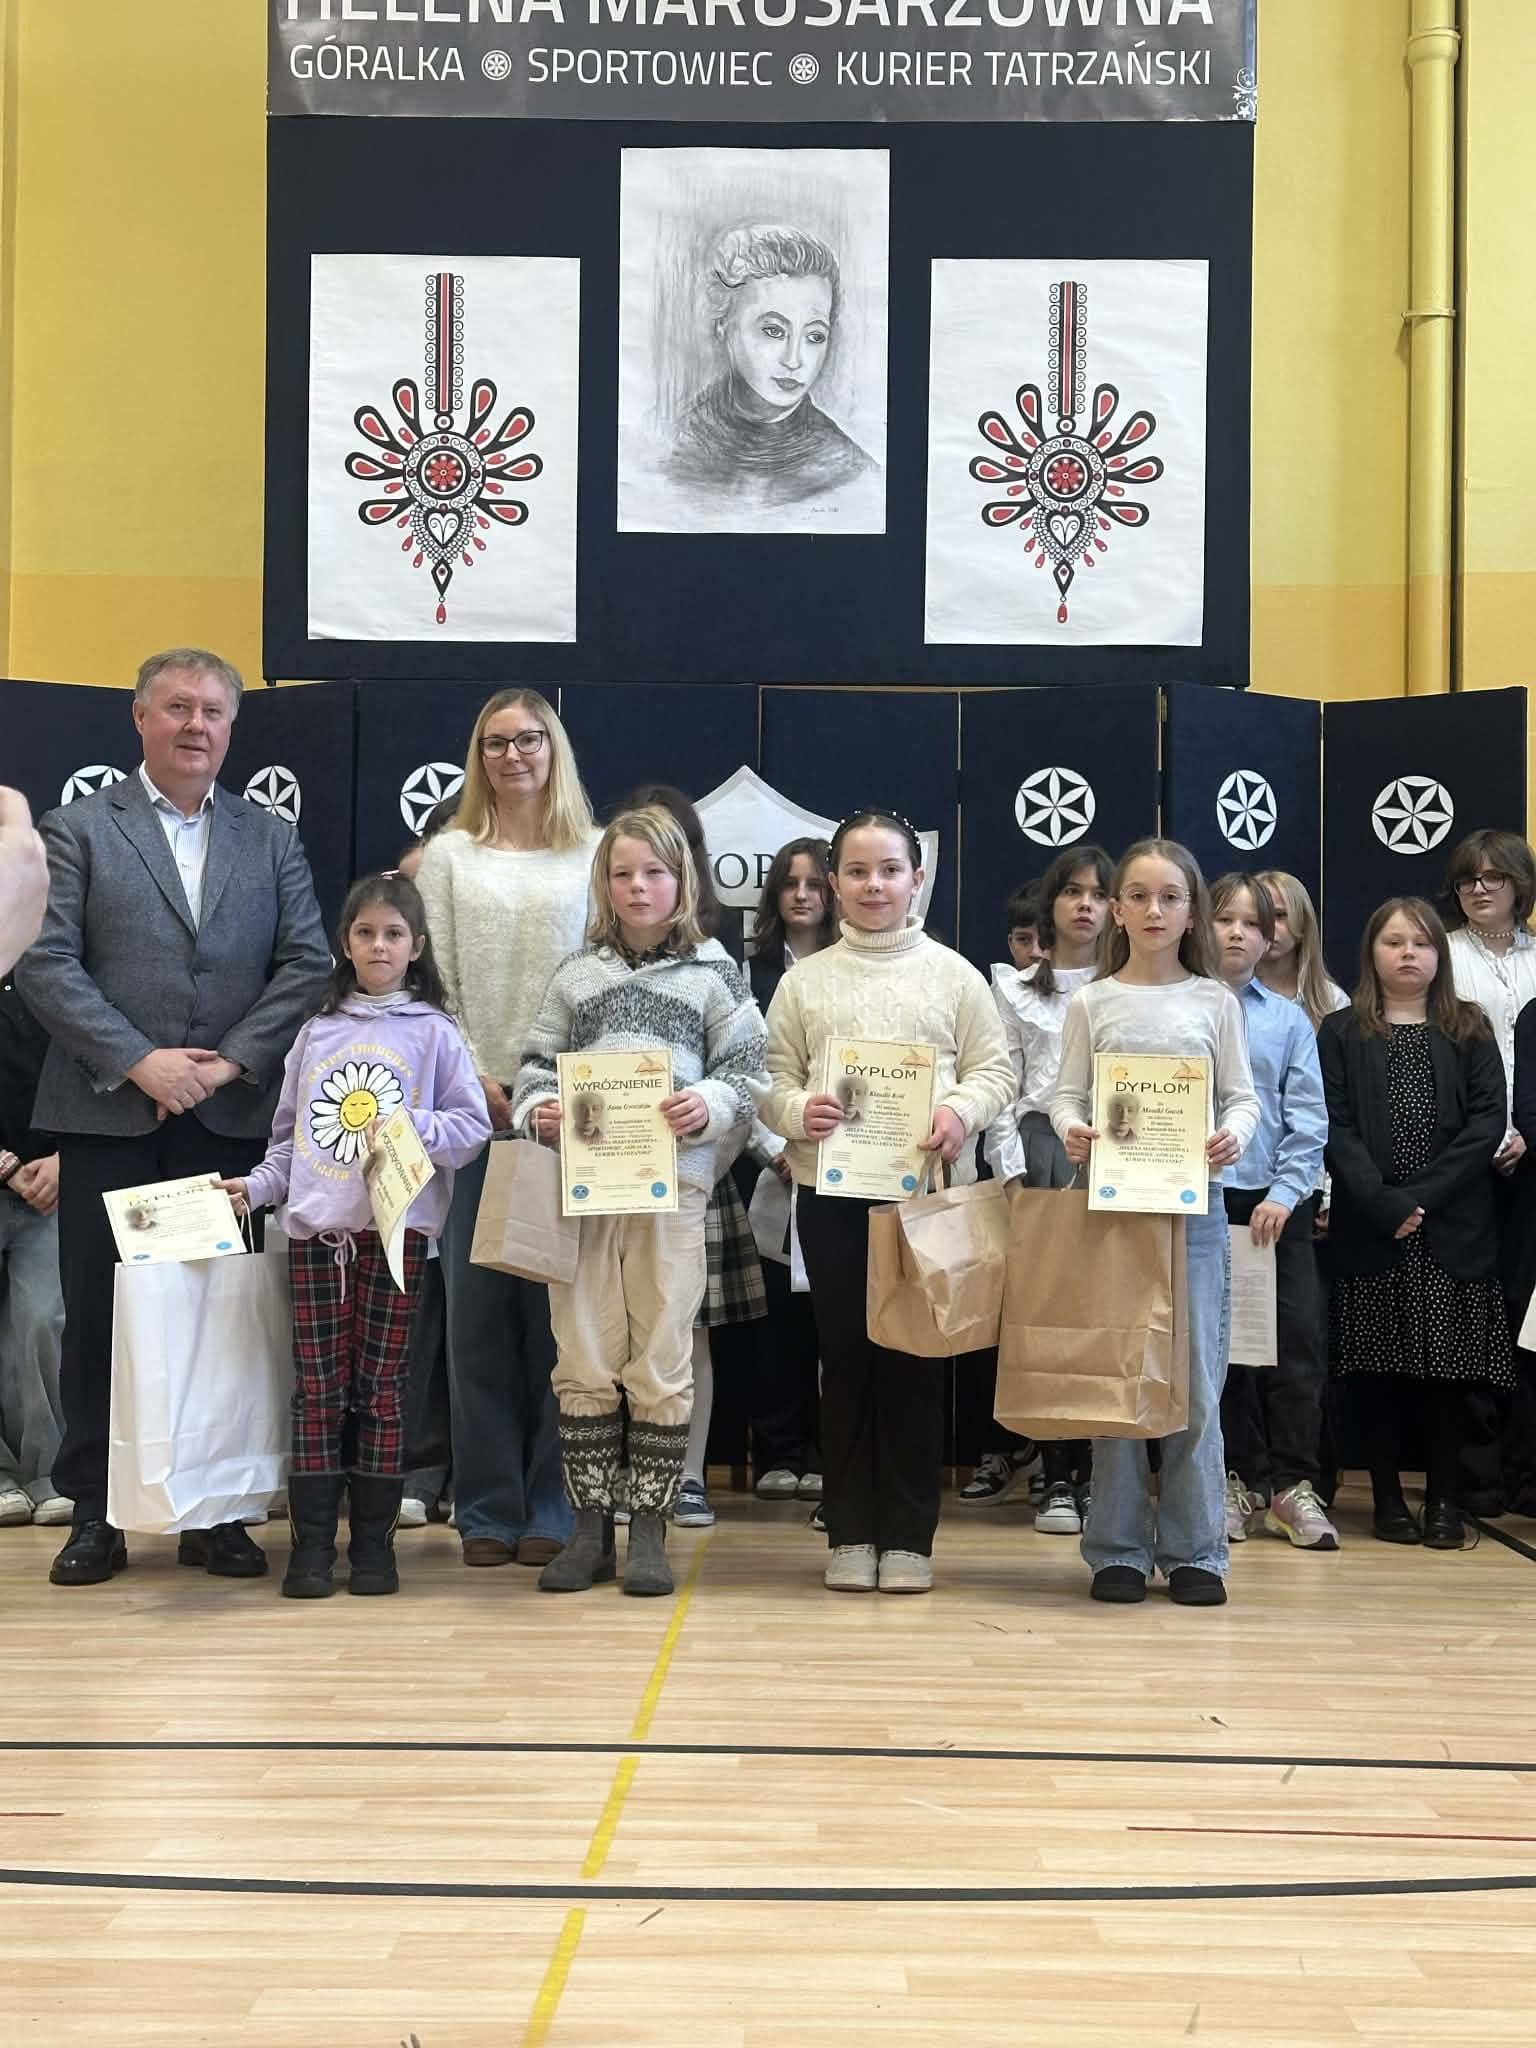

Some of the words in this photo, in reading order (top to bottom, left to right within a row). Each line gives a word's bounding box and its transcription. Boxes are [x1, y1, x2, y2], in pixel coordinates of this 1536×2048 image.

[290, 35, 465, 81] GÓRALKA
[528, 47, 773, 86] SPORTOWIEC
[837, 51, 972, 86] KURIER
[983, 40, 1210, 86] TATRZAŃSKI
[846, 1064, 917, 1080] DYPLOM
[573, 1078, 663, 1091] WYRÓŻNIENIE
[1115, 1081, 1190, 1094] DYPLOM
